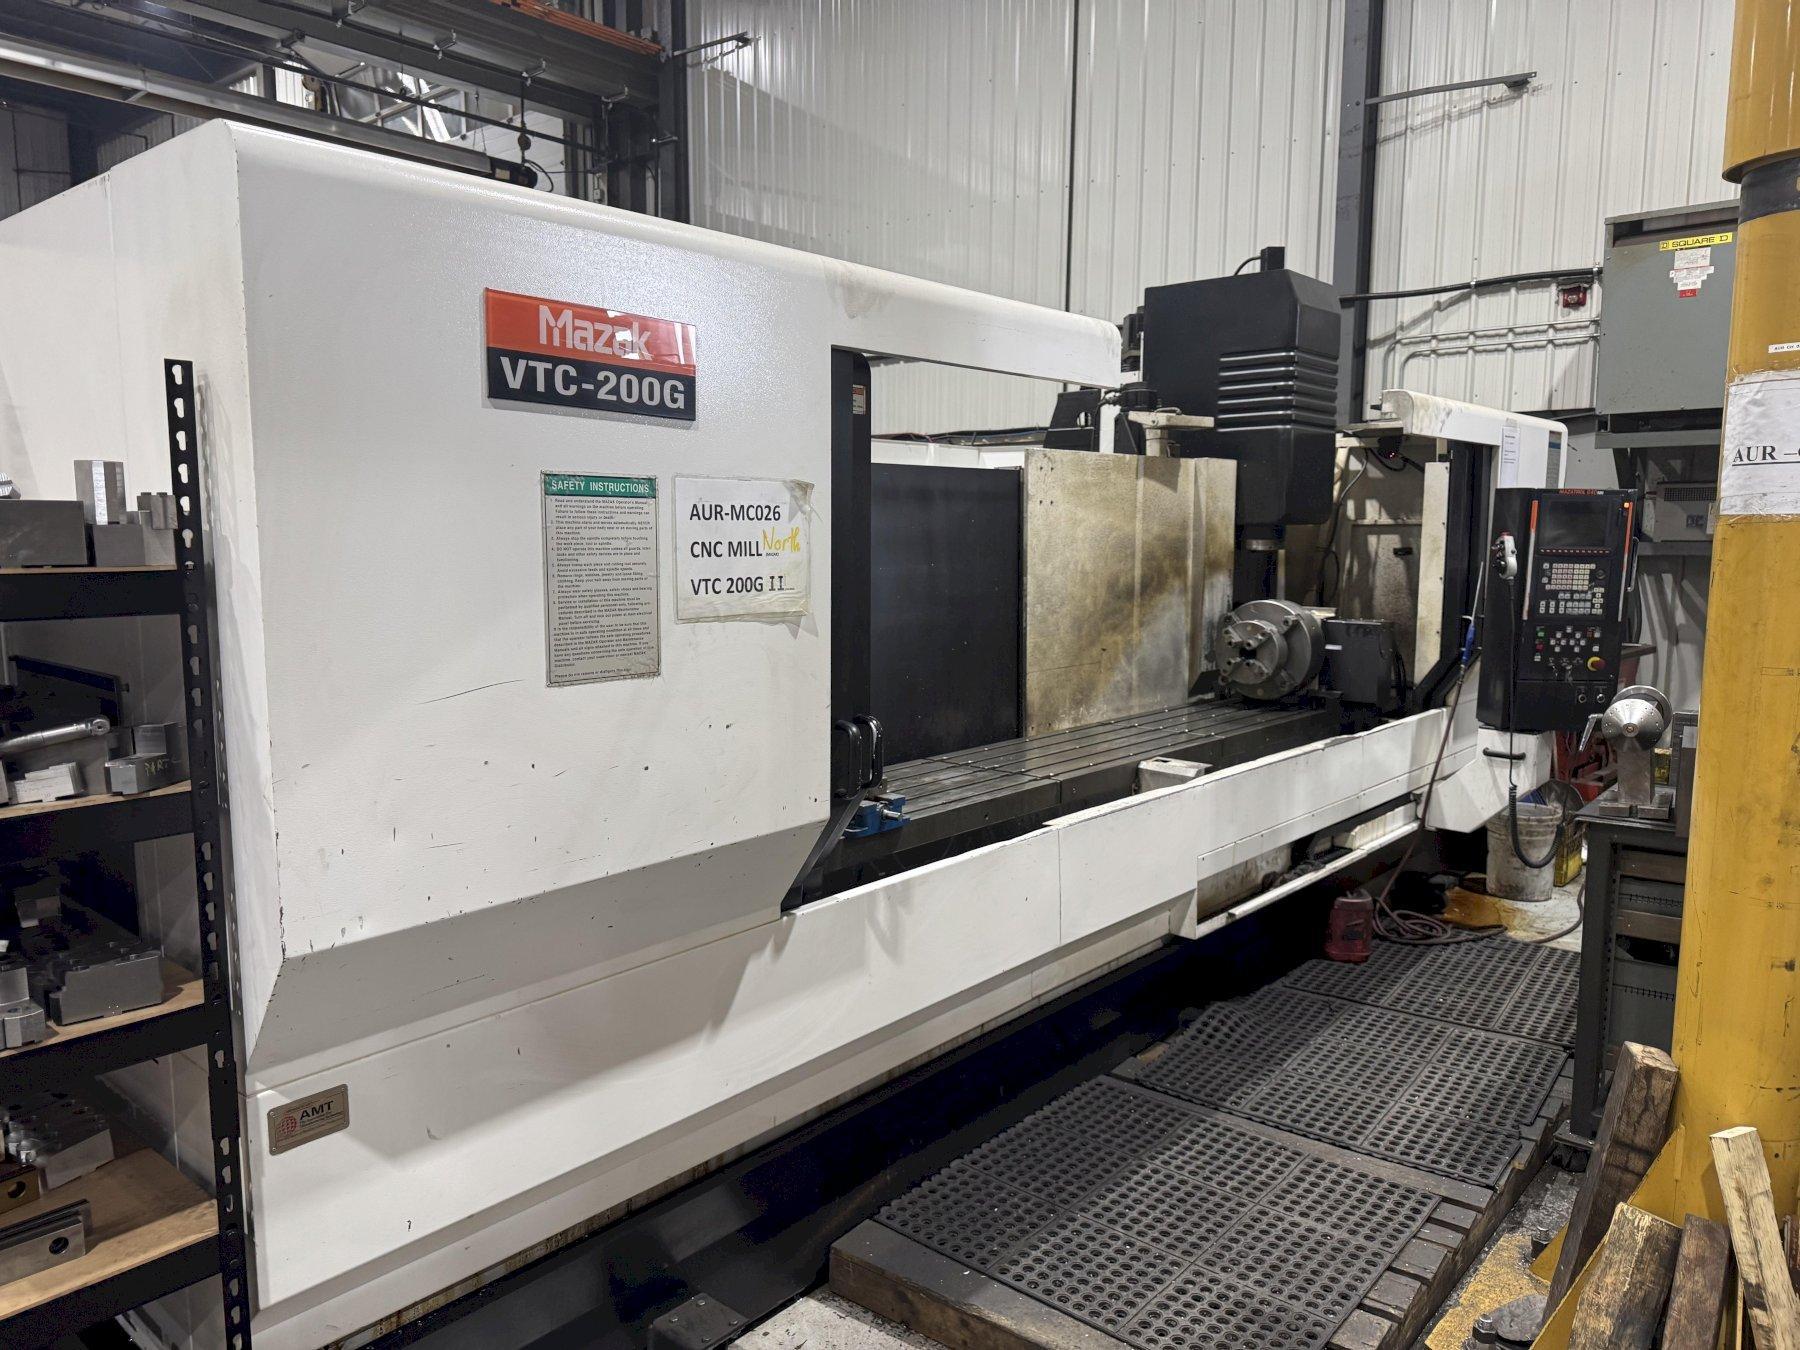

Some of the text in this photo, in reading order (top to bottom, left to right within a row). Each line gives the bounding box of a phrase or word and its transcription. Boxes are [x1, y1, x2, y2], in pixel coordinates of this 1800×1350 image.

[1671, 234, 1729, 248] SQUARE D
[539, 304, 652, 361] Mazak
[500, 356, 686, 410] VTC-200G
[1733, 445, 1778, 462] AUR
[551, 480, 650, 493] SAFETY INSTRUCTIONS
[689, 503, 781, 521] AUR-MC026
[690, 540, 763, 558] CNC MILL
[762, 526, 801, 553] North
[690, 575, 785, 595] VTC 200G II
[299, 1100, 335, 1120] AMT
